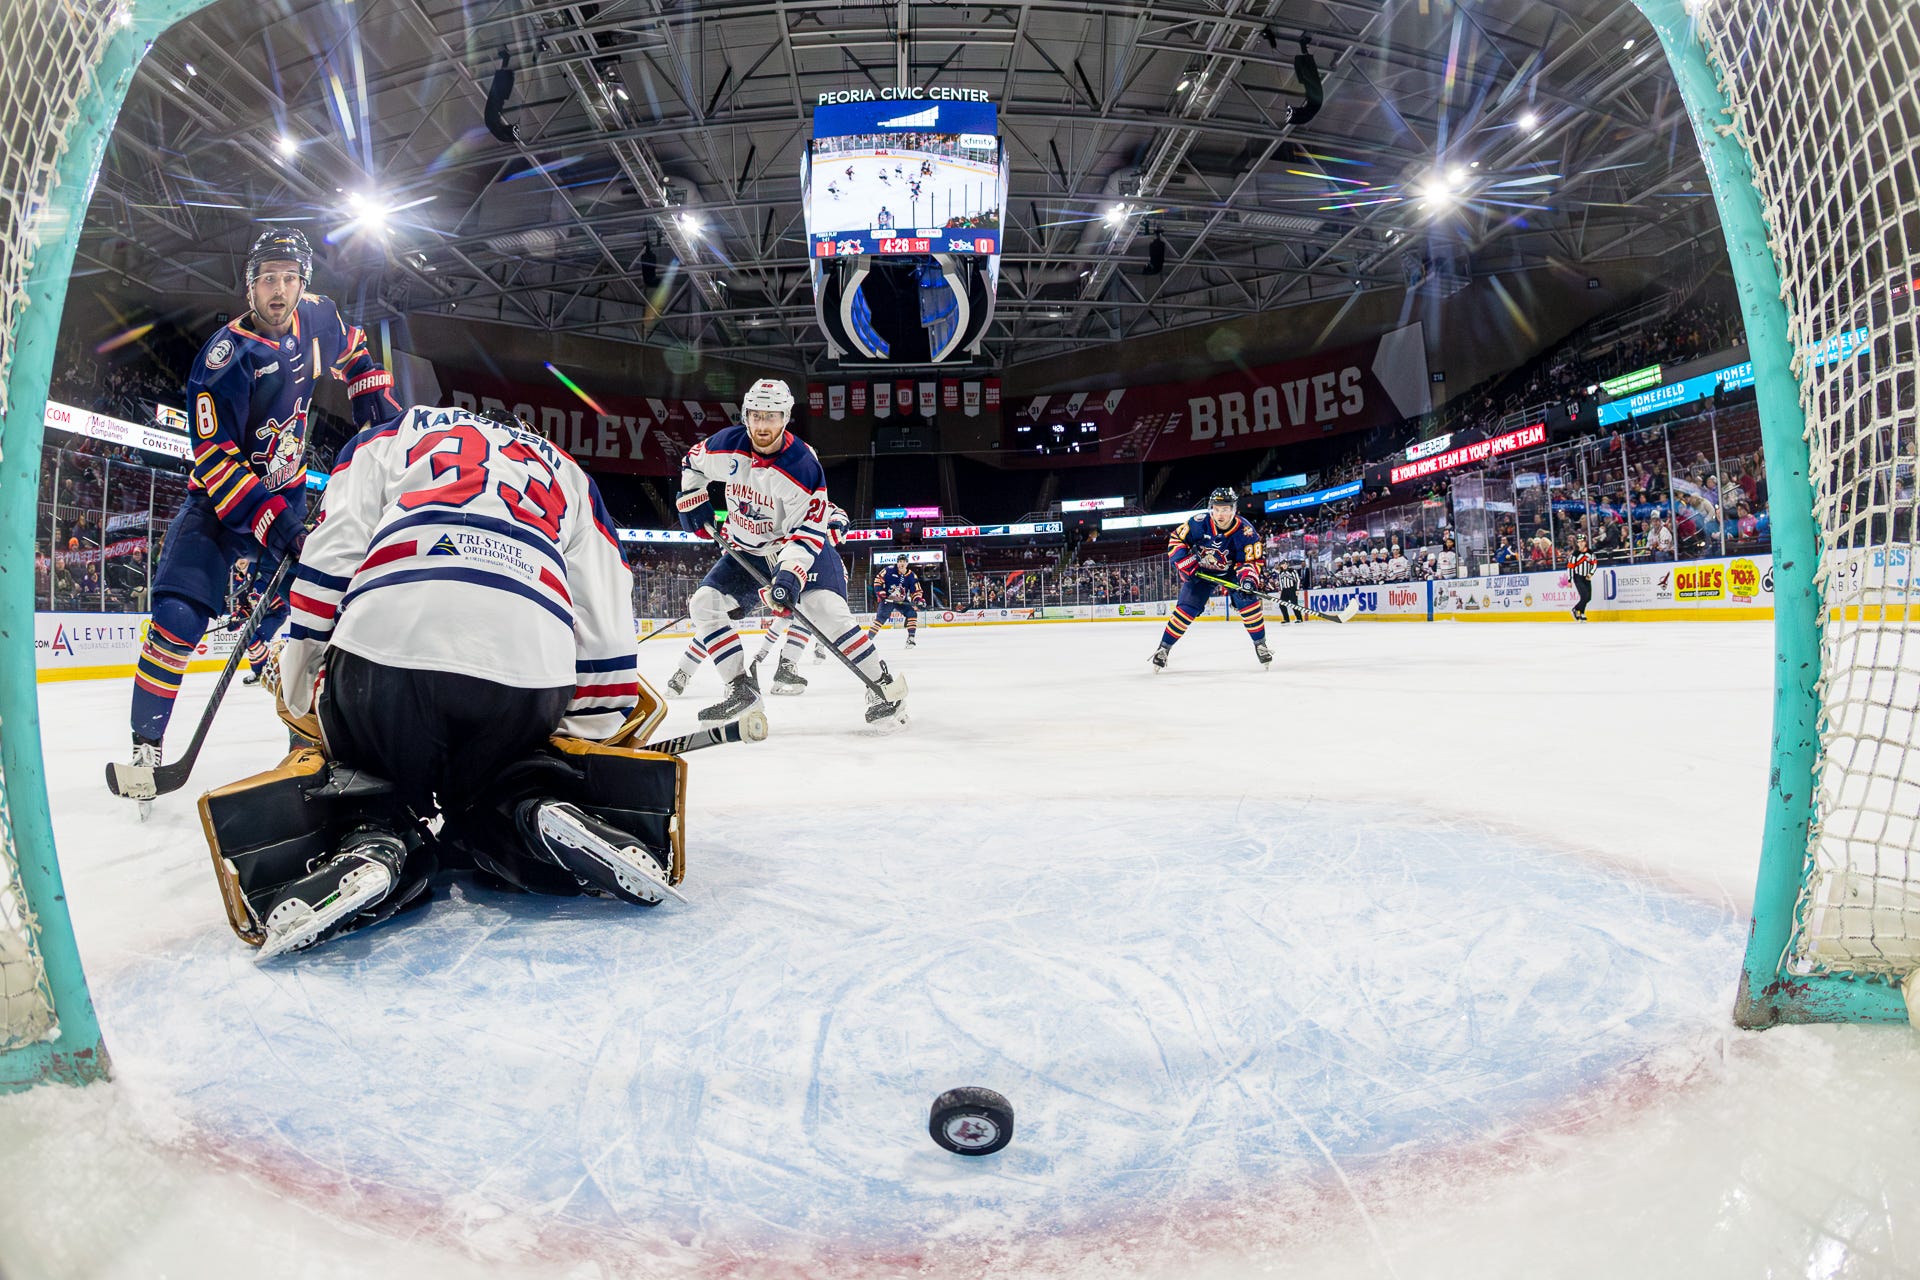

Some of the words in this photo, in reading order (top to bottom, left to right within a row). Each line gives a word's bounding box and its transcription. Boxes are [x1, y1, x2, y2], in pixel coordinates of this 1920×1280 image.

[818, 89, 876, 106] PEORIA
[880, 87, 924, 100] CIVIC
[929, 87, 989, 103] CENTER
[962, 137, 994, 147] xfinity
[823, 243, 829, 256] 1
[883, 239, 909, 252] 4:26
[914, 240, 928, 250] 1ST
[980, 240, 987, 253] 0
[347, 374, 391, 401] WARRIOR
[1630, 383, 1685, 408] HOMEFIELD
[1188, 366, 1364, 441] BRAVES
[1567, 402, 1579, 416] 113
[195, 392, 218, 439] 8
[91, 425, 123, 441] Companies
[1400, 464, 1417, 479] YOUR
[1417, 458, 1438, 475] HOME
[1438, 452, 1459, 469] TEAM
[1492, 435, 1516, 453] HOME
[1517, 427, 1543, 448] TEAM
[397, 424, 567, 544] 33
[803, 498, 826, 524] 20
[729, 510, 774, 535] HUNDERBOLTS
[457, 533, 523, 558] TRI-STATE
[1244, 542, 1263, 562] 28
[463, 545, 535, 574] ORTHOPAEDICS
[1507, 575, 1529, 587] ANDERSON
[1617, 576, 1651, 586] DEMPSER
[1677, 568, 1722, 589] OLLIE'S
[1542, 592, 1567, 601] MOLLY
[73, 627, 135, 641] LEVITT
[213, 630, 238, 642] Home
